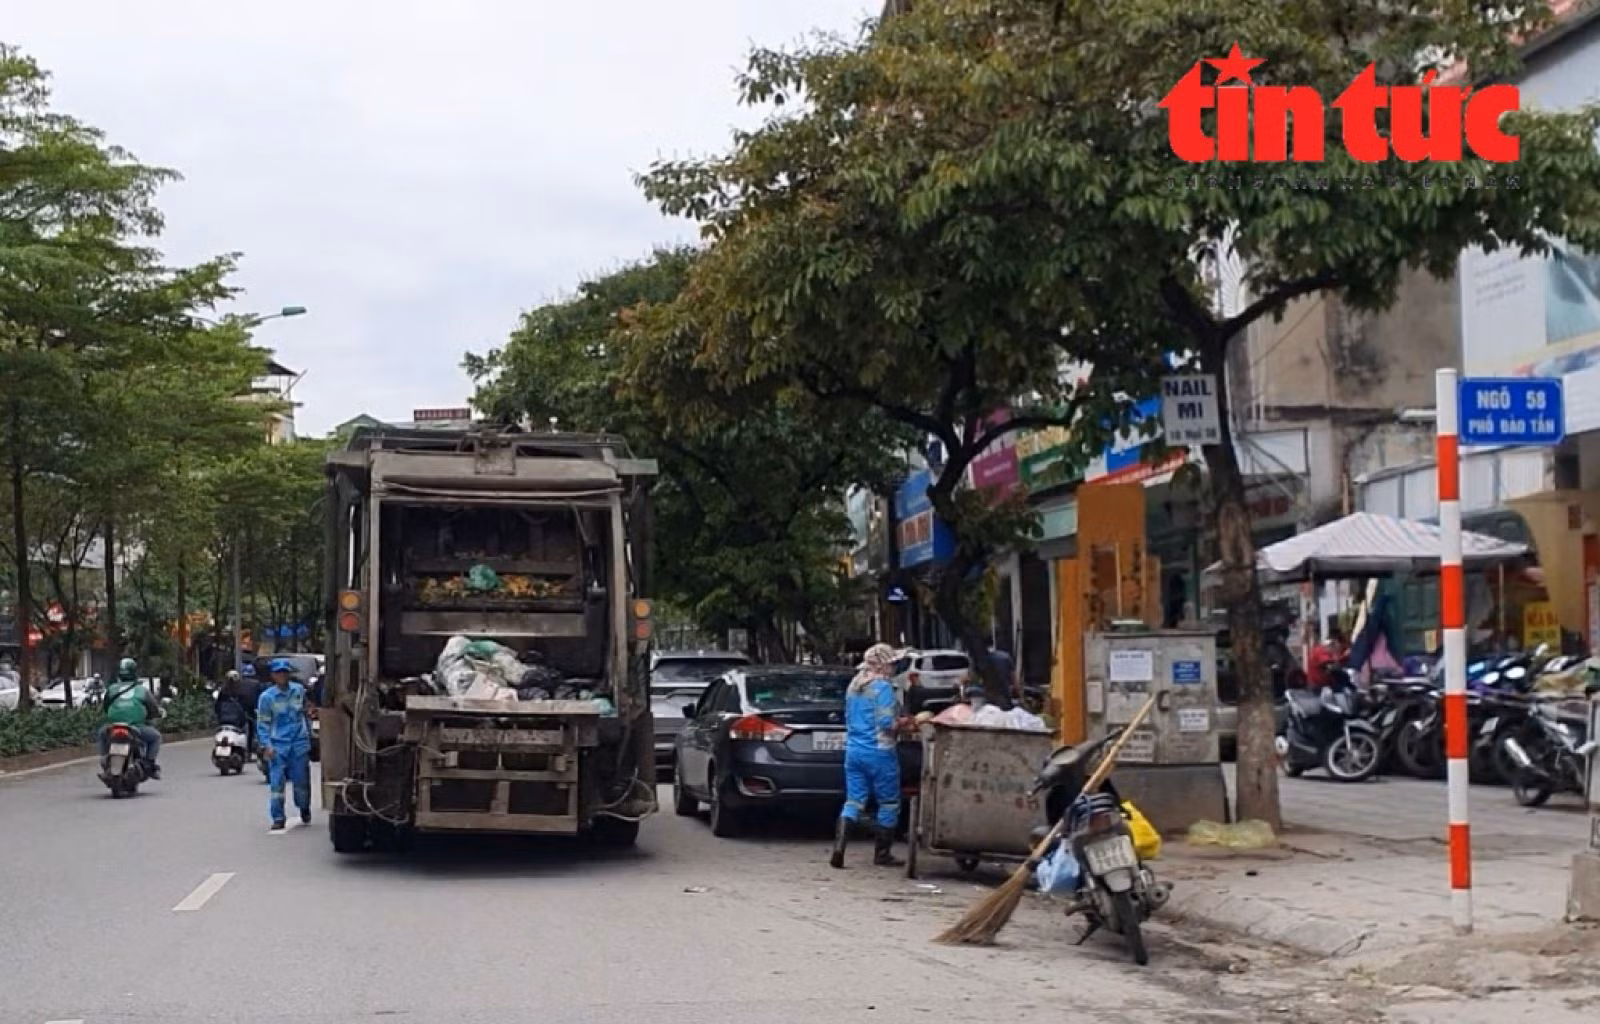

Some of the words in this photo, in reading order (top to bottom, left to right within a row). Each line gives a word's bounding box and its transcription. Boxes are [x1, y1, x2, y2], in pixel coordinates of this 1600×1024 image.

[1164, 379, 1212, 397] NAIL
[1476, 385, 1511, 410] NGÕ
[1525, 389, 1547, 410] 58
[1177, 402, 1204, 419] MI
[1467, 413, 1495, 434] PHỐ
